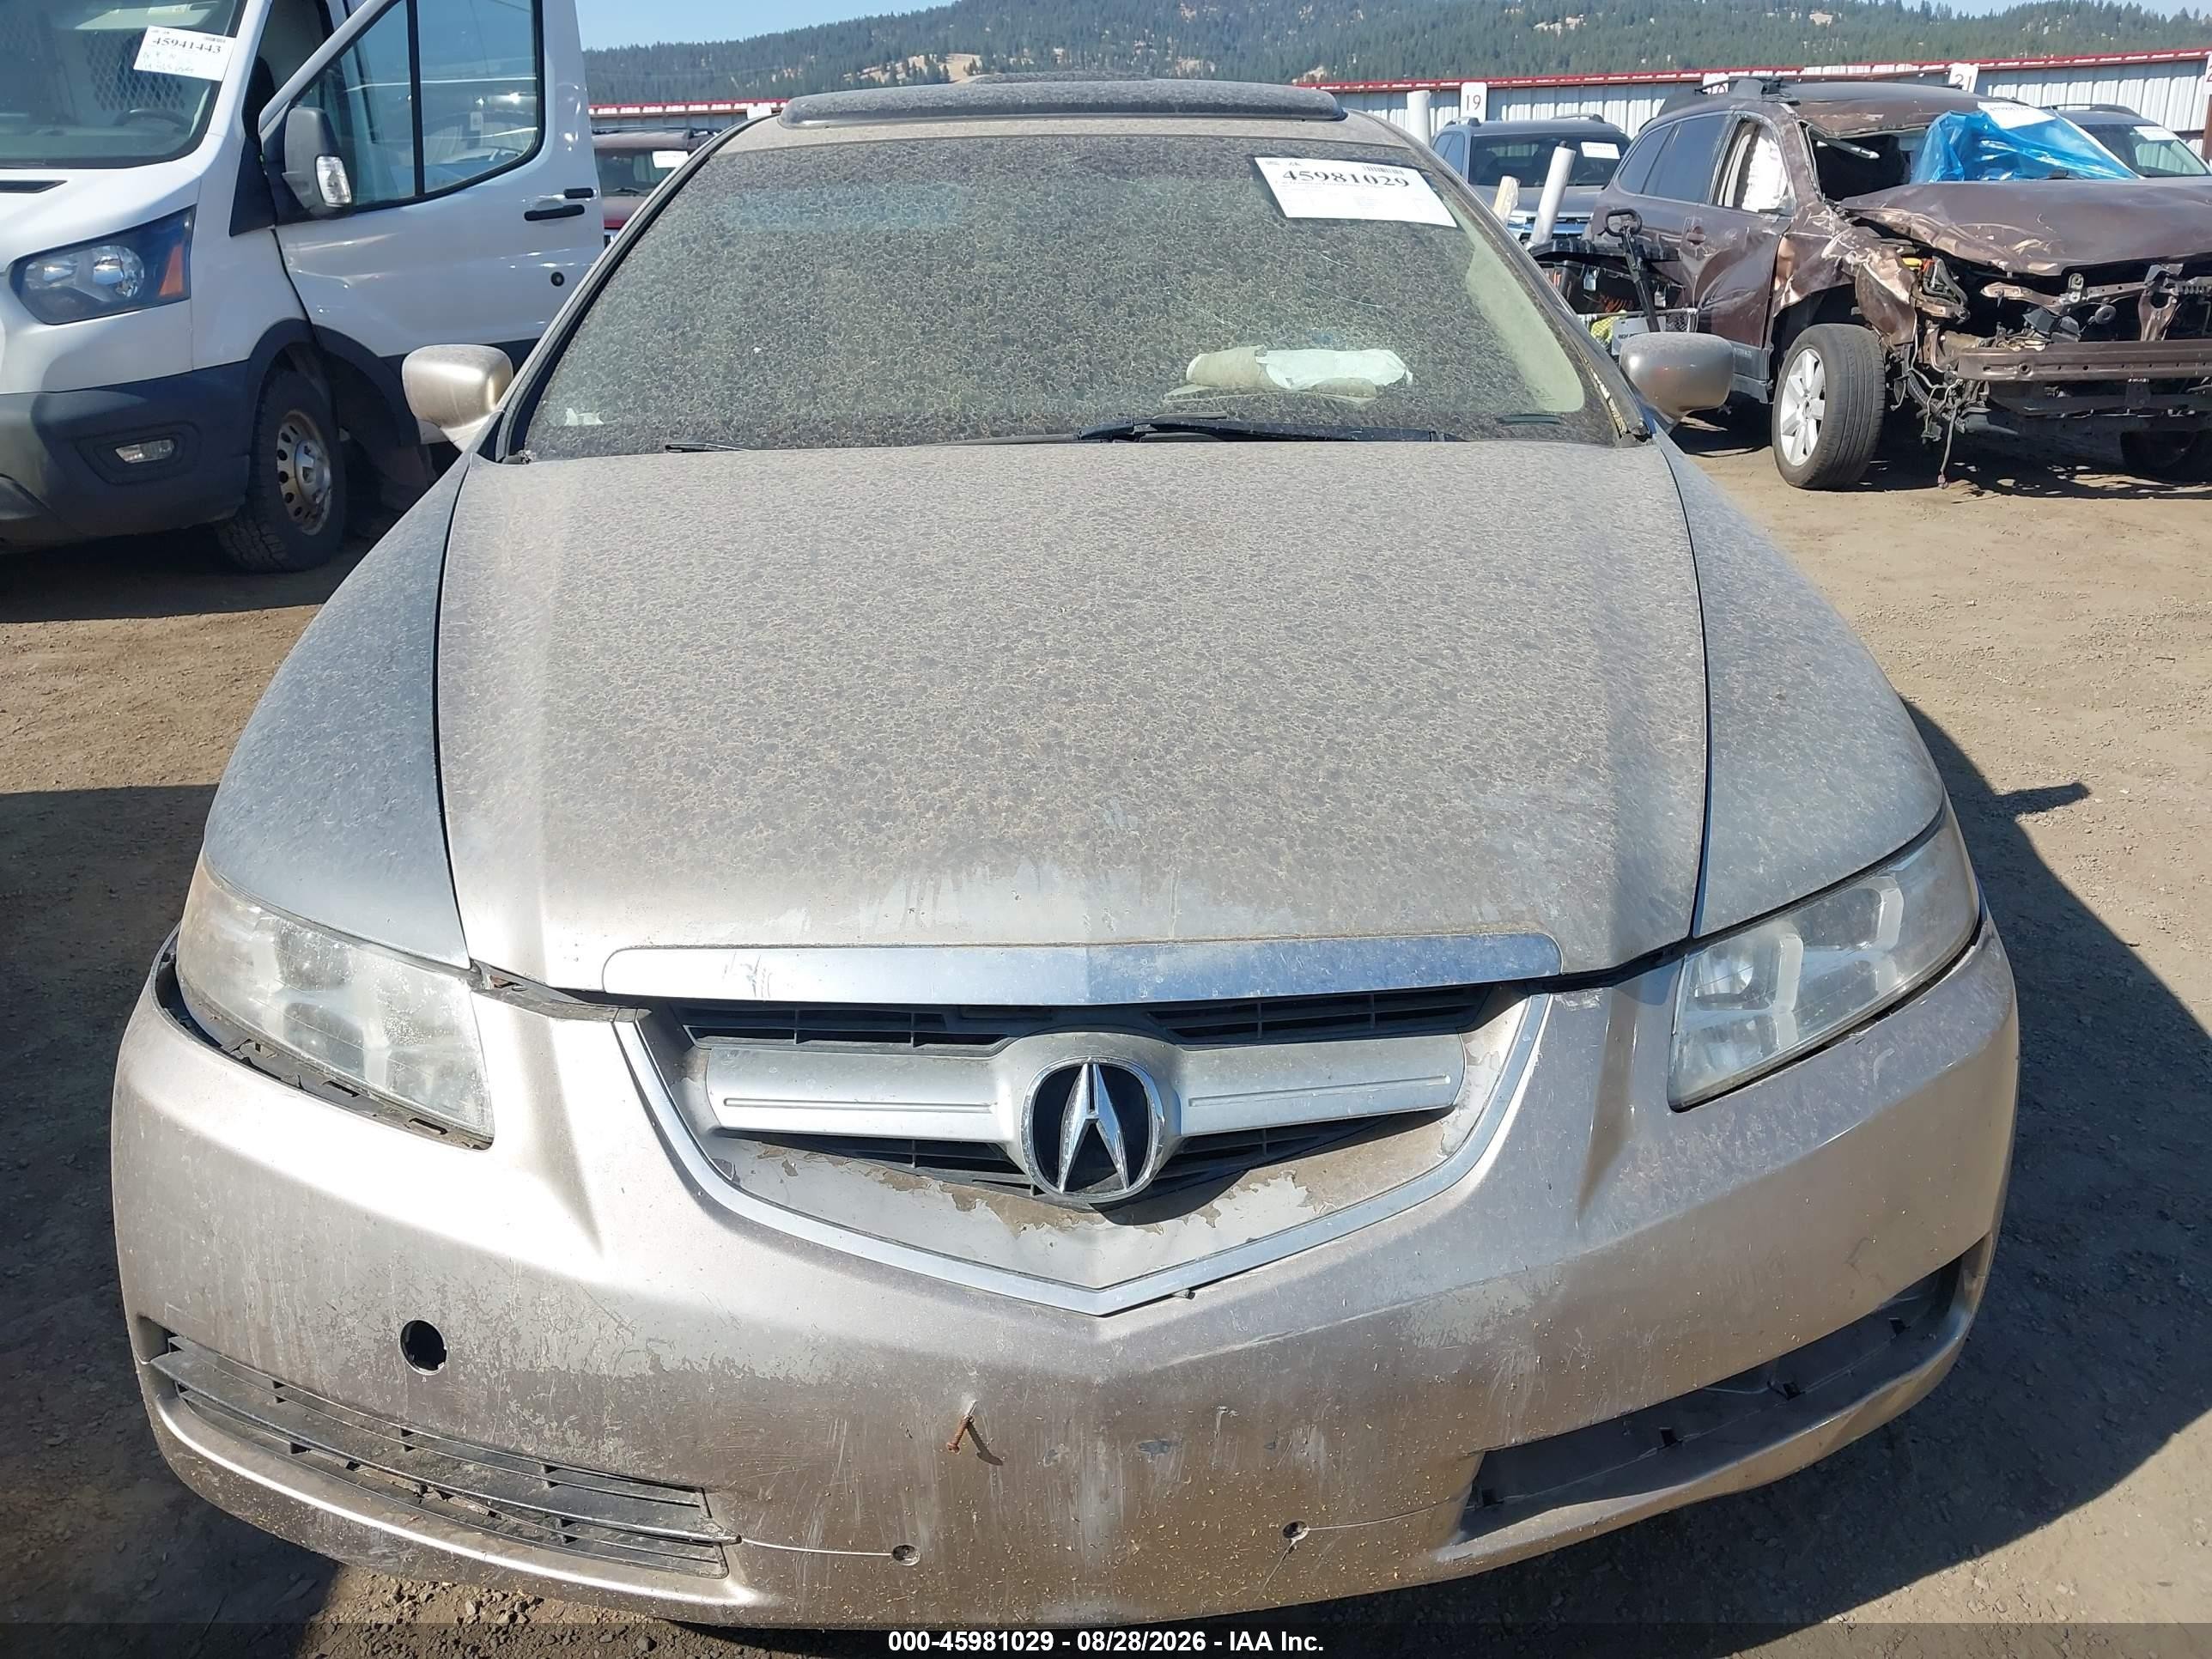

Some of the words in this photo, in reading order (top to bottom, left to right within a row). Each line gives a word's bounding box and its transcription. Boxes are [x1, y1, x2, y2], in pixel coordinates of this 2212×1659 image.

[152, 37, 222, 54] 45941443
[1954, 74, 1972, 91] 21
[1466, 94, 1481, 111] 19
[1282, 170, 1411, 187] 45981029
